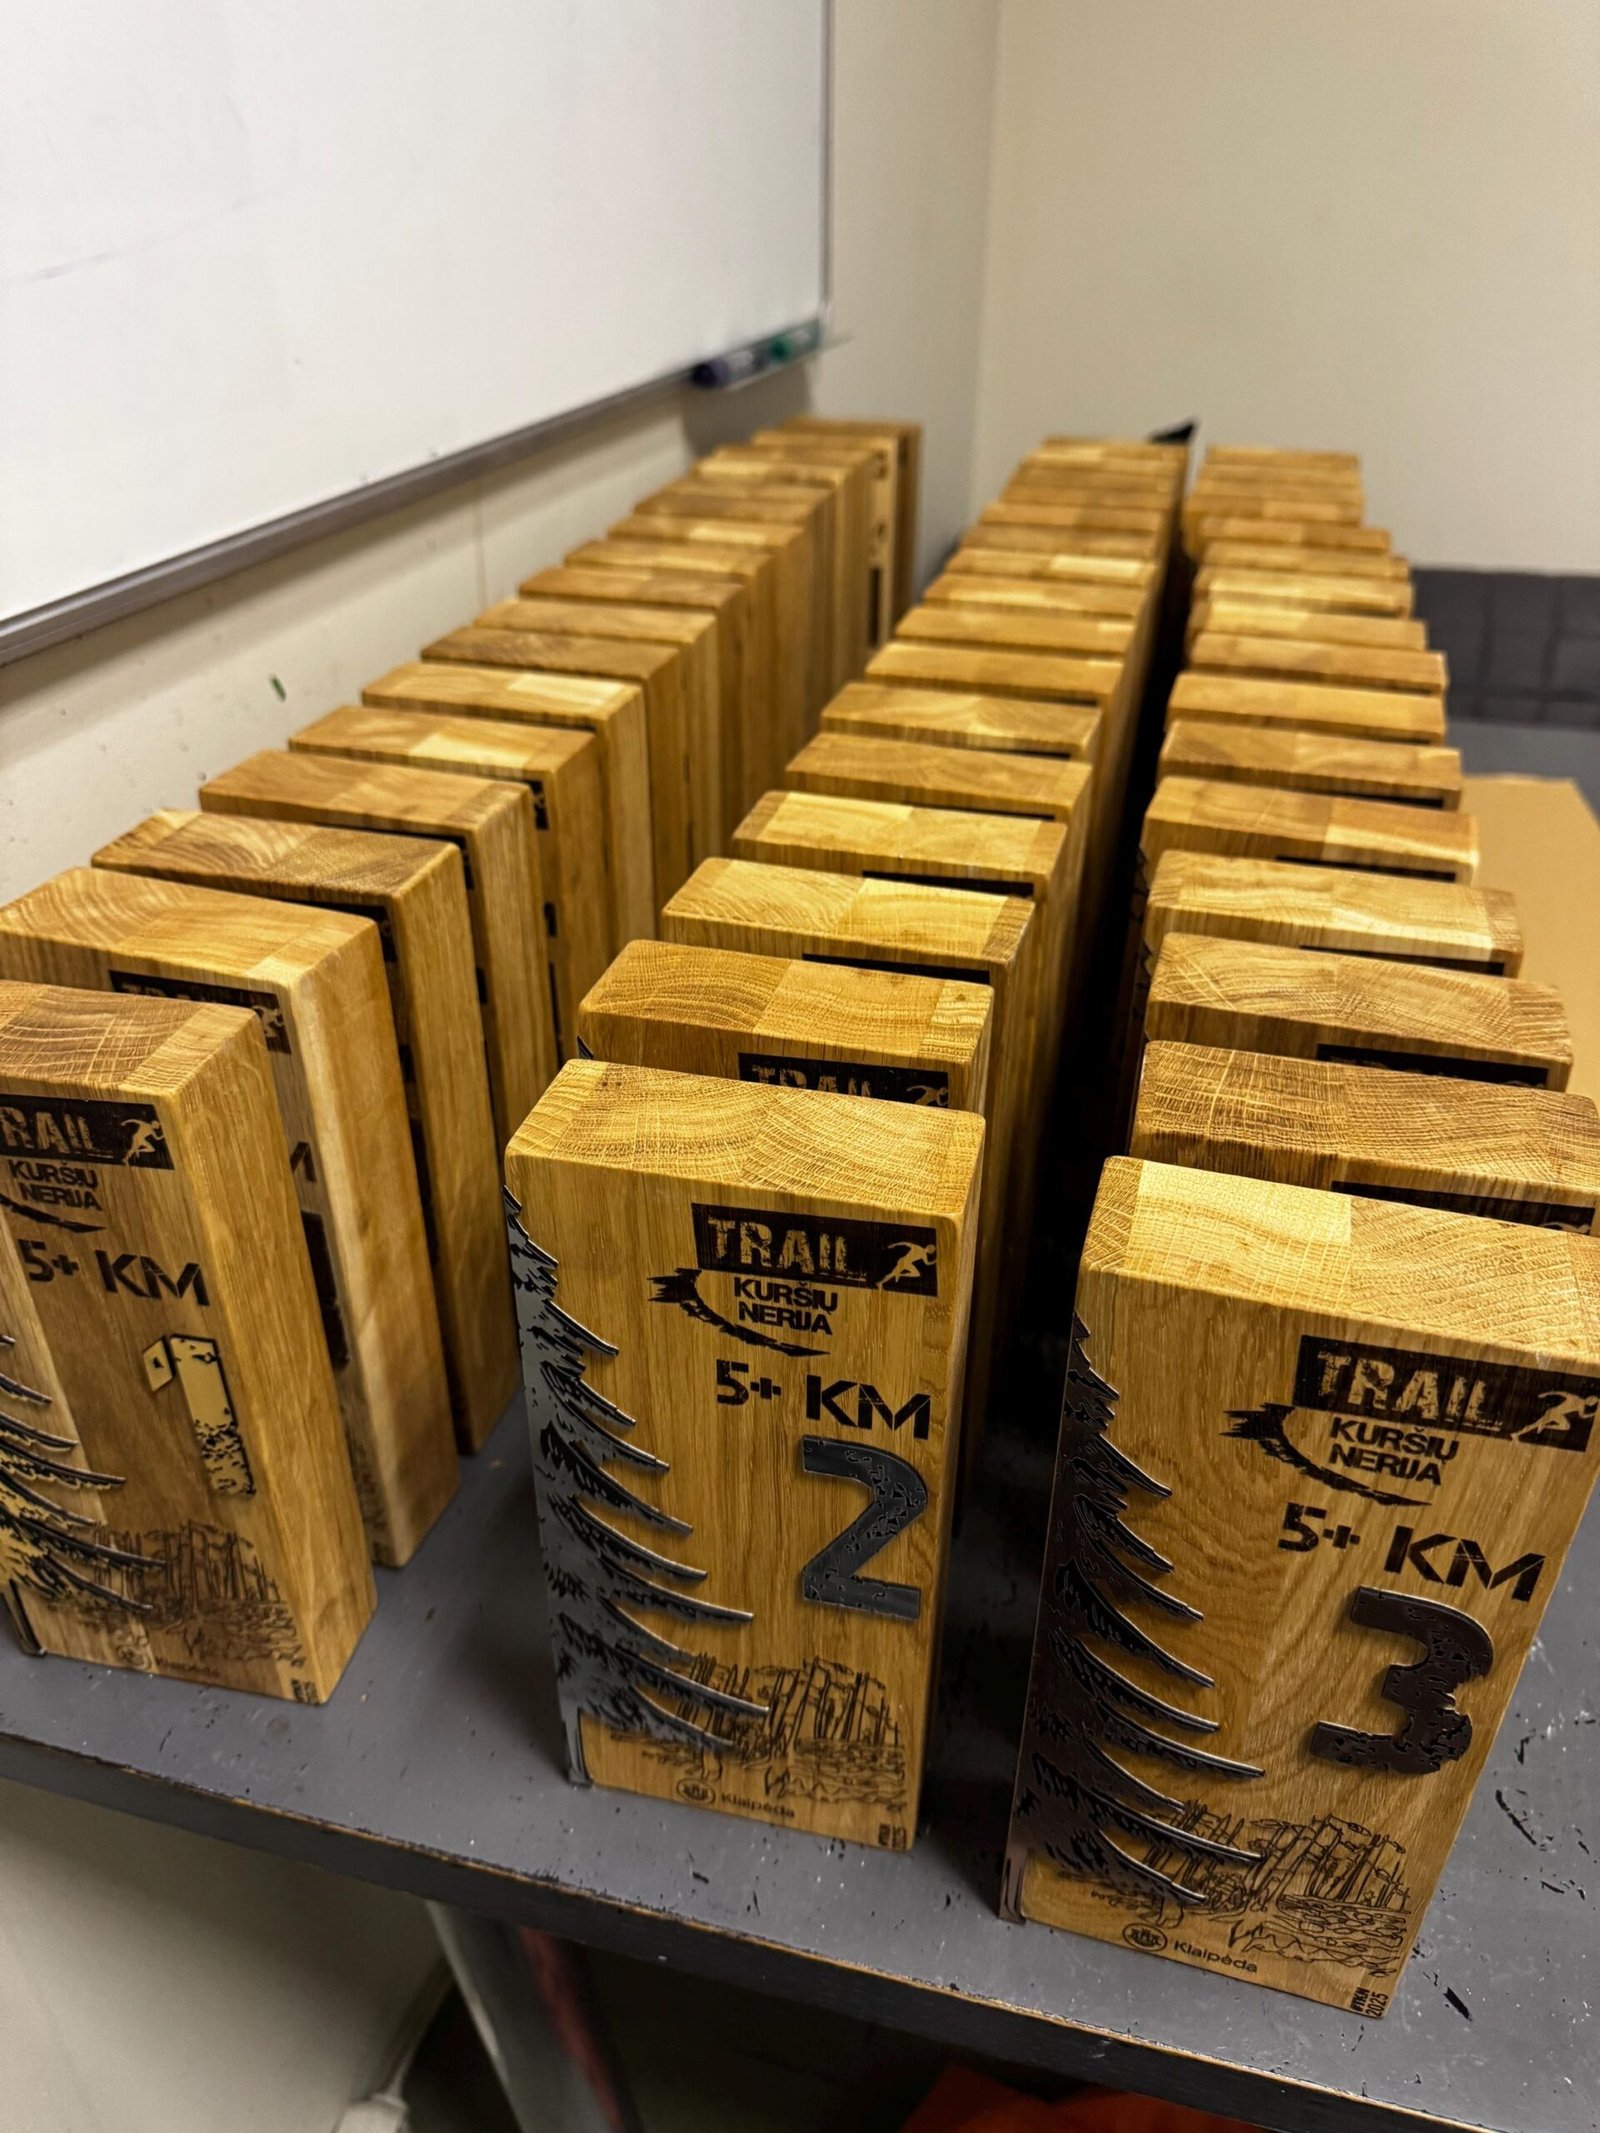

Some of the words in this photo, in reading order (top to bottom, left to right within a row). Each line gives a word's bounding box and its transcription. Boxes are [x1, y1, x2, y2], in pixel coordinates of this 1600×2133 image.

[17, 1239, 79, 1282] 5+
[95, 1250, 210, 1306] KM
[708, 1216, 868, 1282] TRAIL
[143, 1333, 256, 1495] 1
[716, 1359, 781, 1405] 5+
[806, 1375, 931, 1440] KM
[1317, 1351, 1502, 1432] TRAIL
[801, 1435, 928, 1621] 2
[1278, 1502, 1361, 1552] 5+
[1384, 1525, 1546, 1603] KM
[1309, 1585, 1494, 1775] 3
[1173, 1939, 1259, 1974] Klaipėda
[1365, 1991, 1389, 2017] 2025
